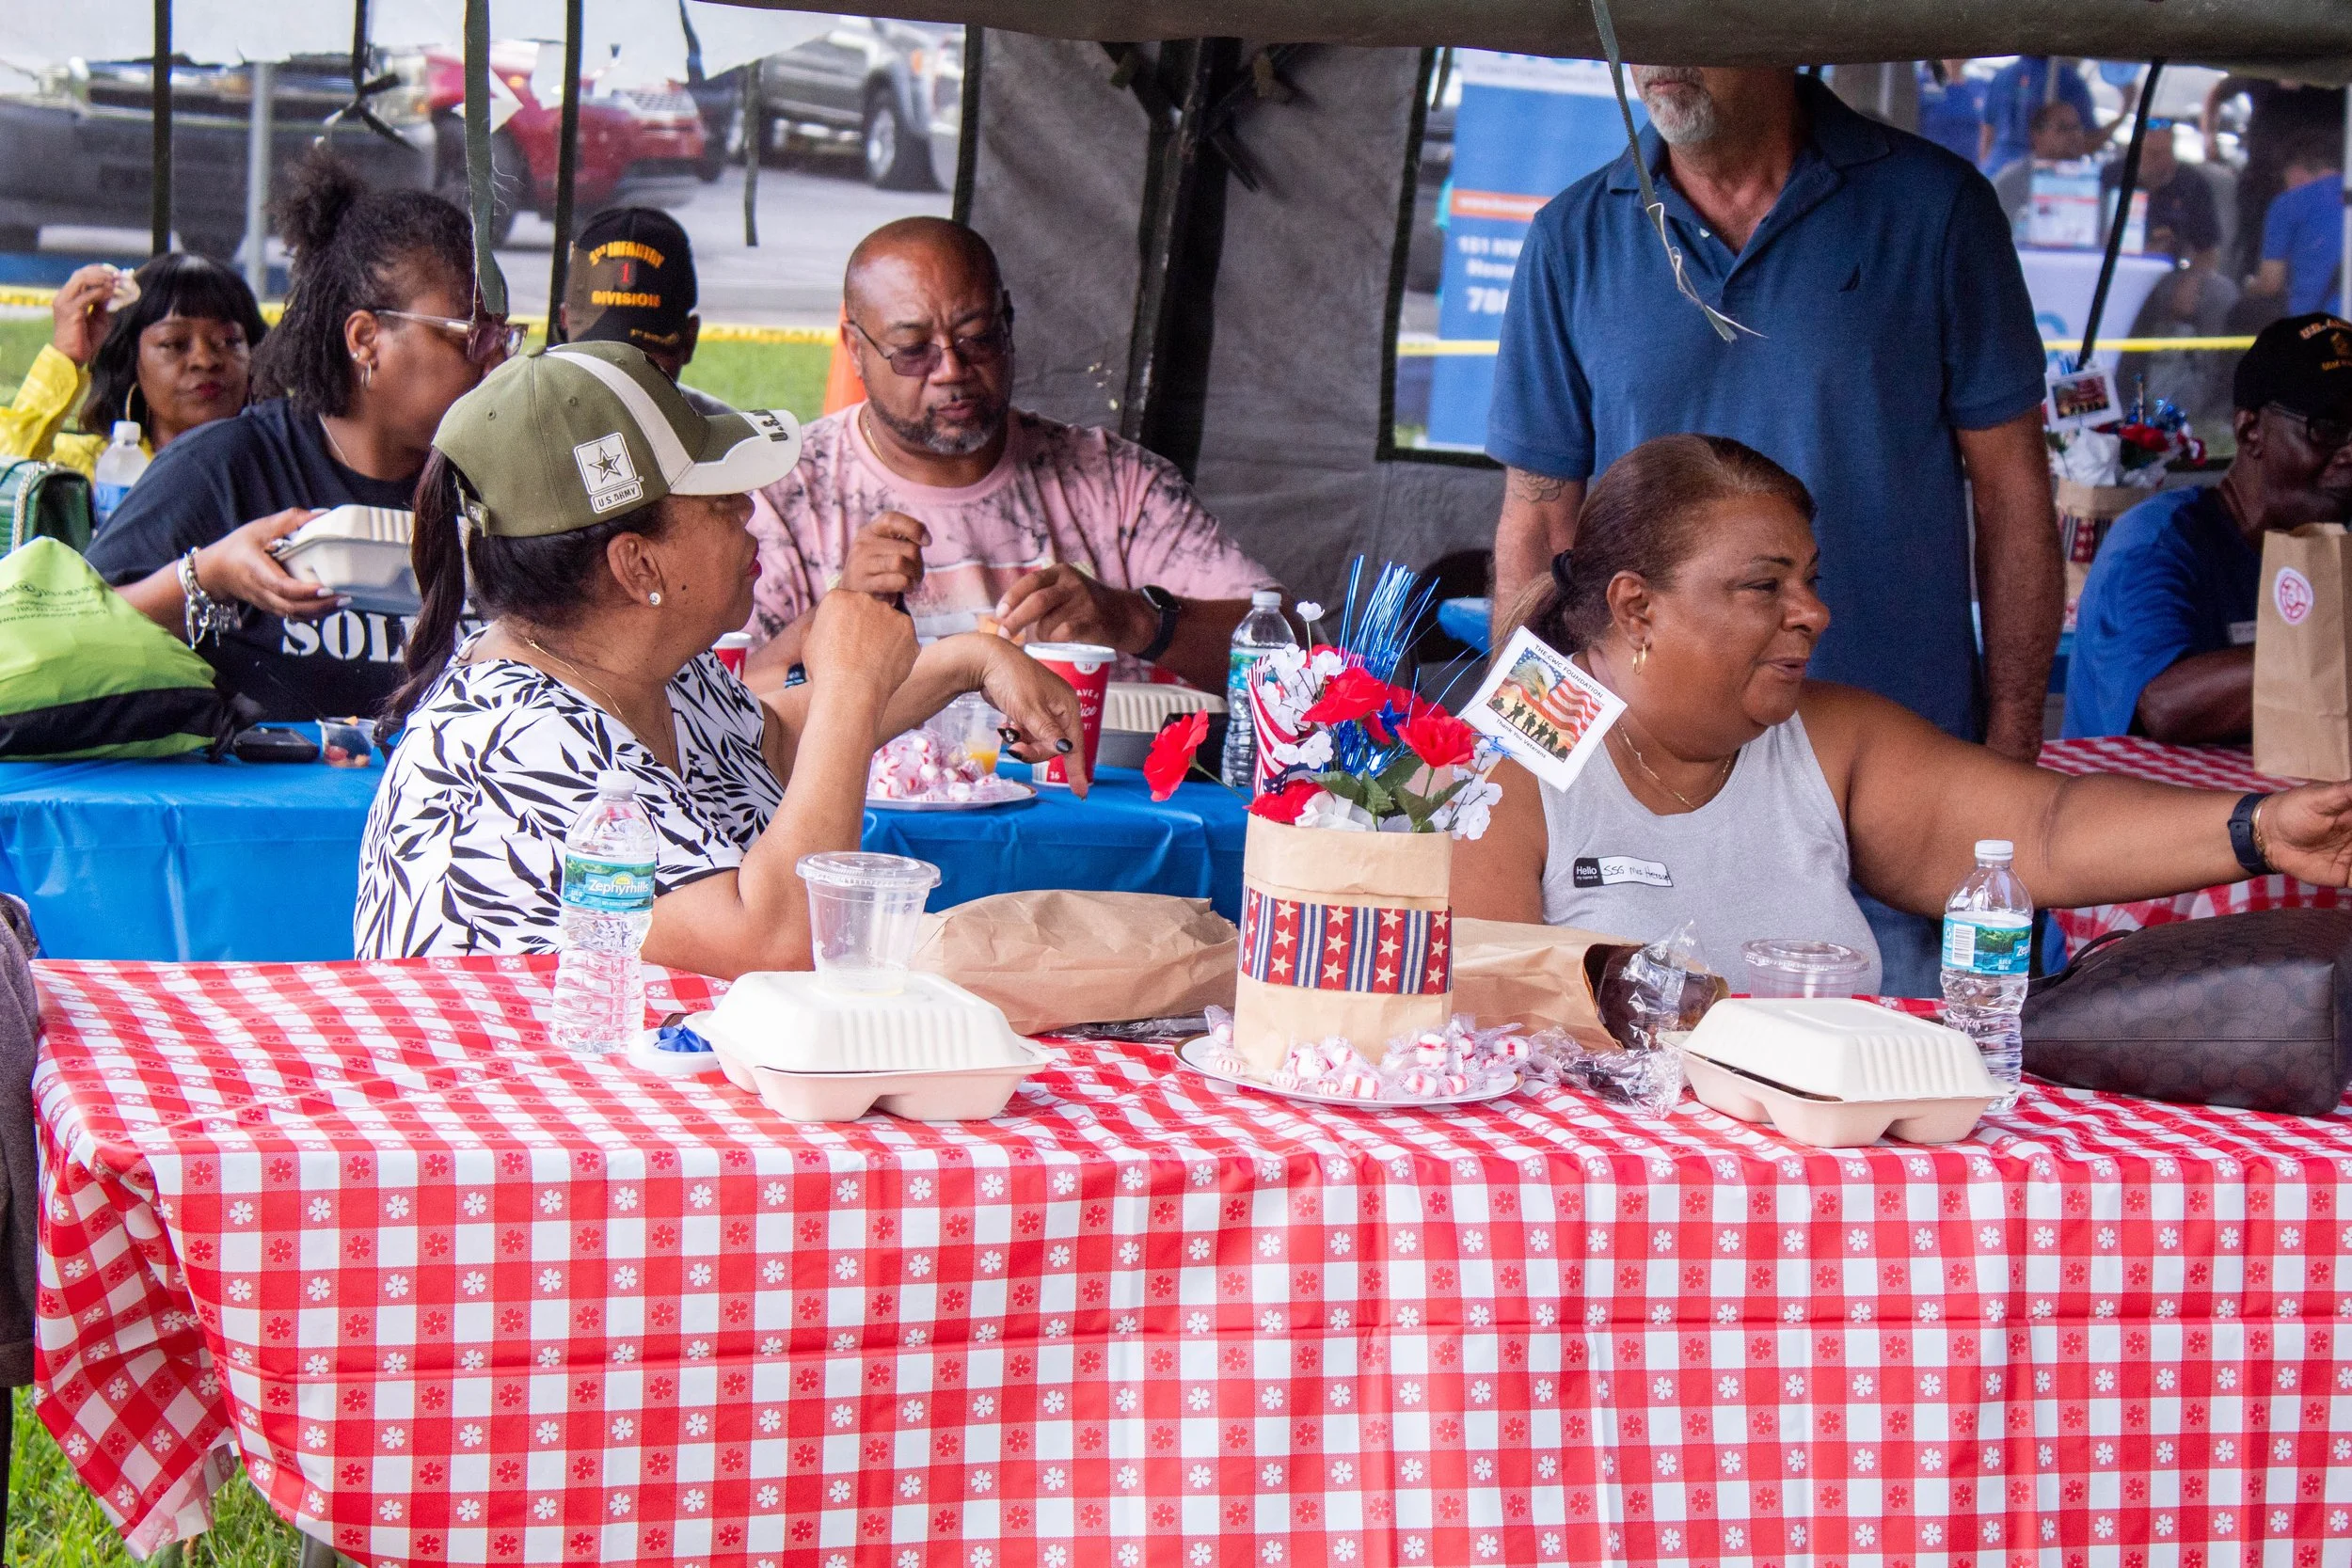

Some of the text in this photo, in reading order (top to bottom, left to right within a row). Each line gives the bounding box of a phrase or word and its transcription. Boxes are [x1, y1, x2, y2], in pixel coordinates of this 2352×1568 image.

[591, 291, 661, 309] DIVISION
[1084, 663, 1093, 672] 16
[1534, 644, 1604, 699] THE CWC FOUNDATION
[1496, 718, 1547, 759] Thank You Veterans
[1576, 865, 1597, 876] Hello
[589, 879, 649, 896] Zephyrhills
